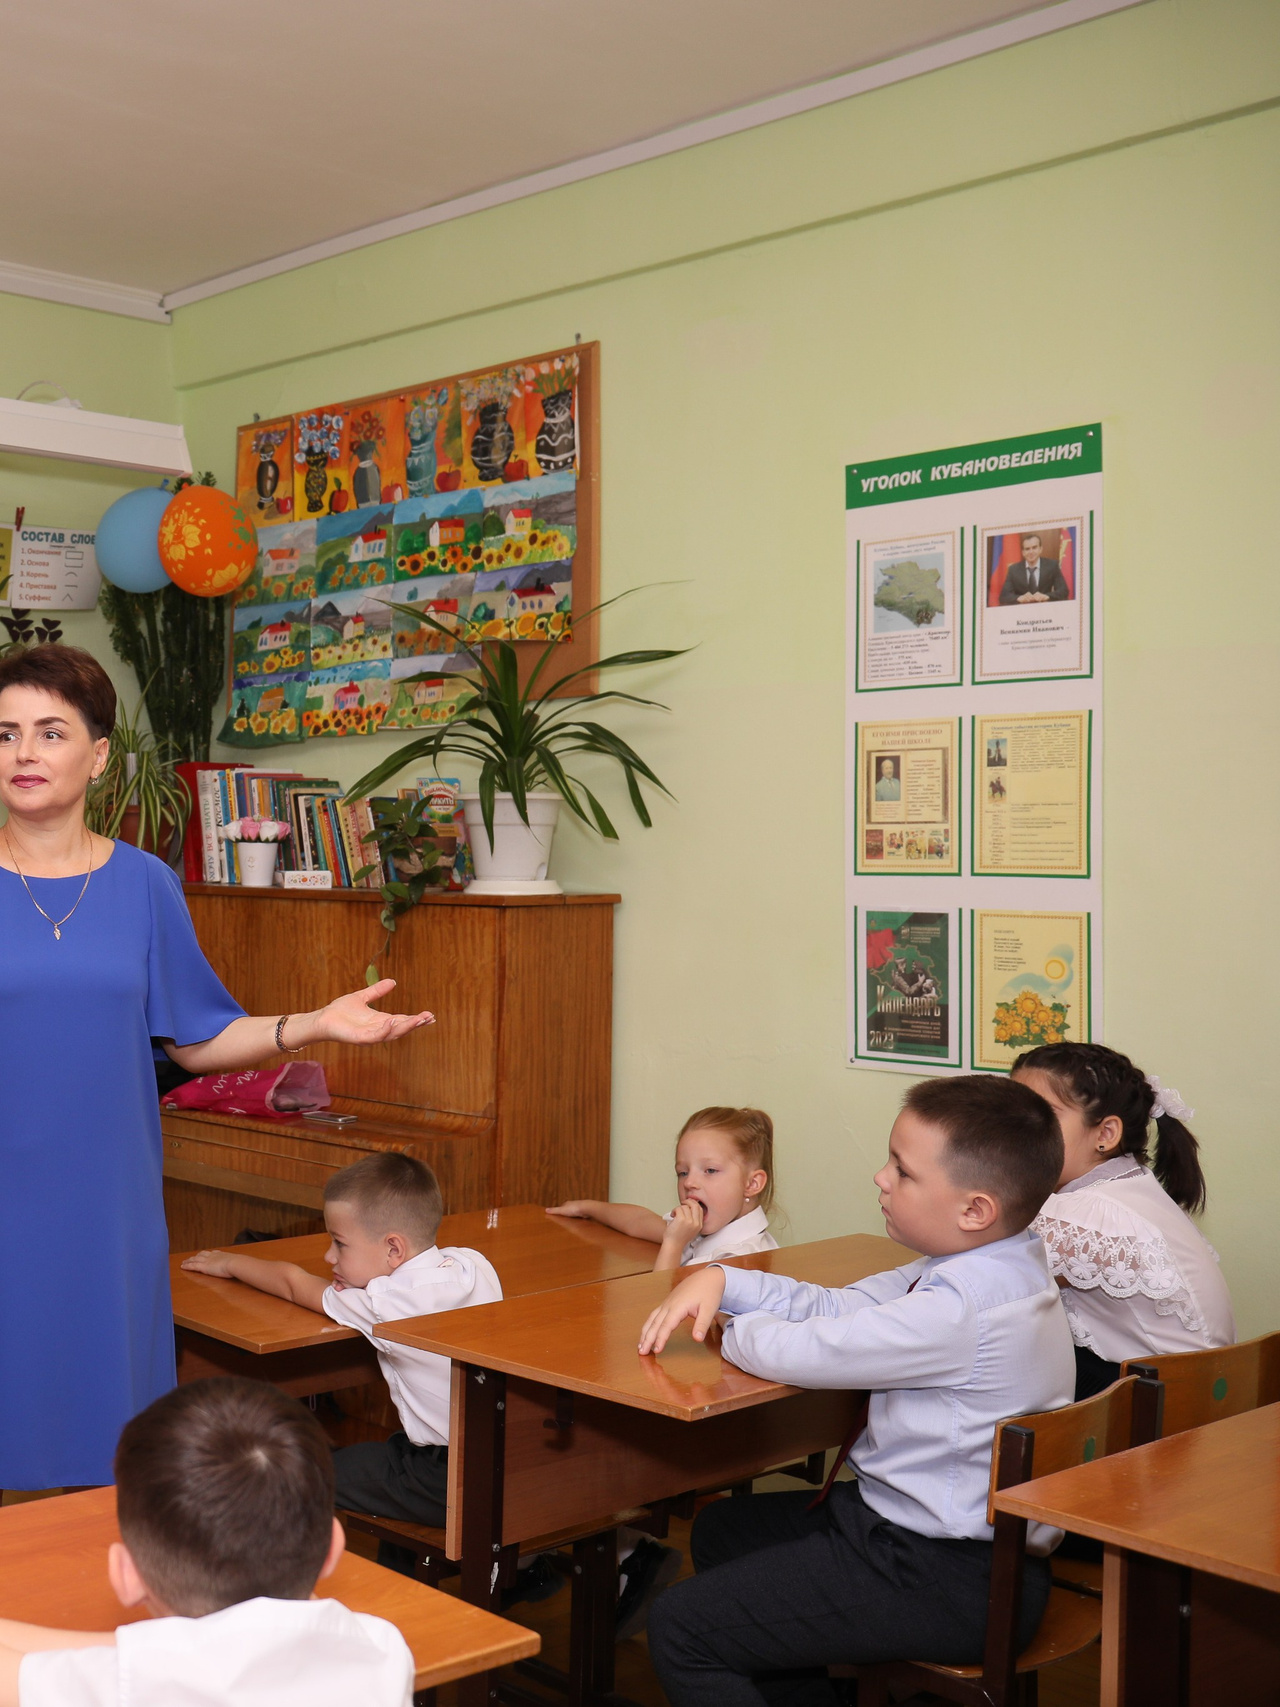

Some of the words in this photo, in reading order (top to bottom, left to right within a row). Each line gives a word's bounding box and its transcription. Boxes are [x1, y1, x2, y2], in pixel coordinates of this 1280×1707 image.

[861, 468, 923, 493] УГОЛОК
[930, 442, 1082, 481] КУБАНОВЕДЕНИЯ
[21, 531, 65, 543] СОСТАВ
[205, 832, 214, 852] ВСЕ
[869, 1030, 895, 1050] 2023
